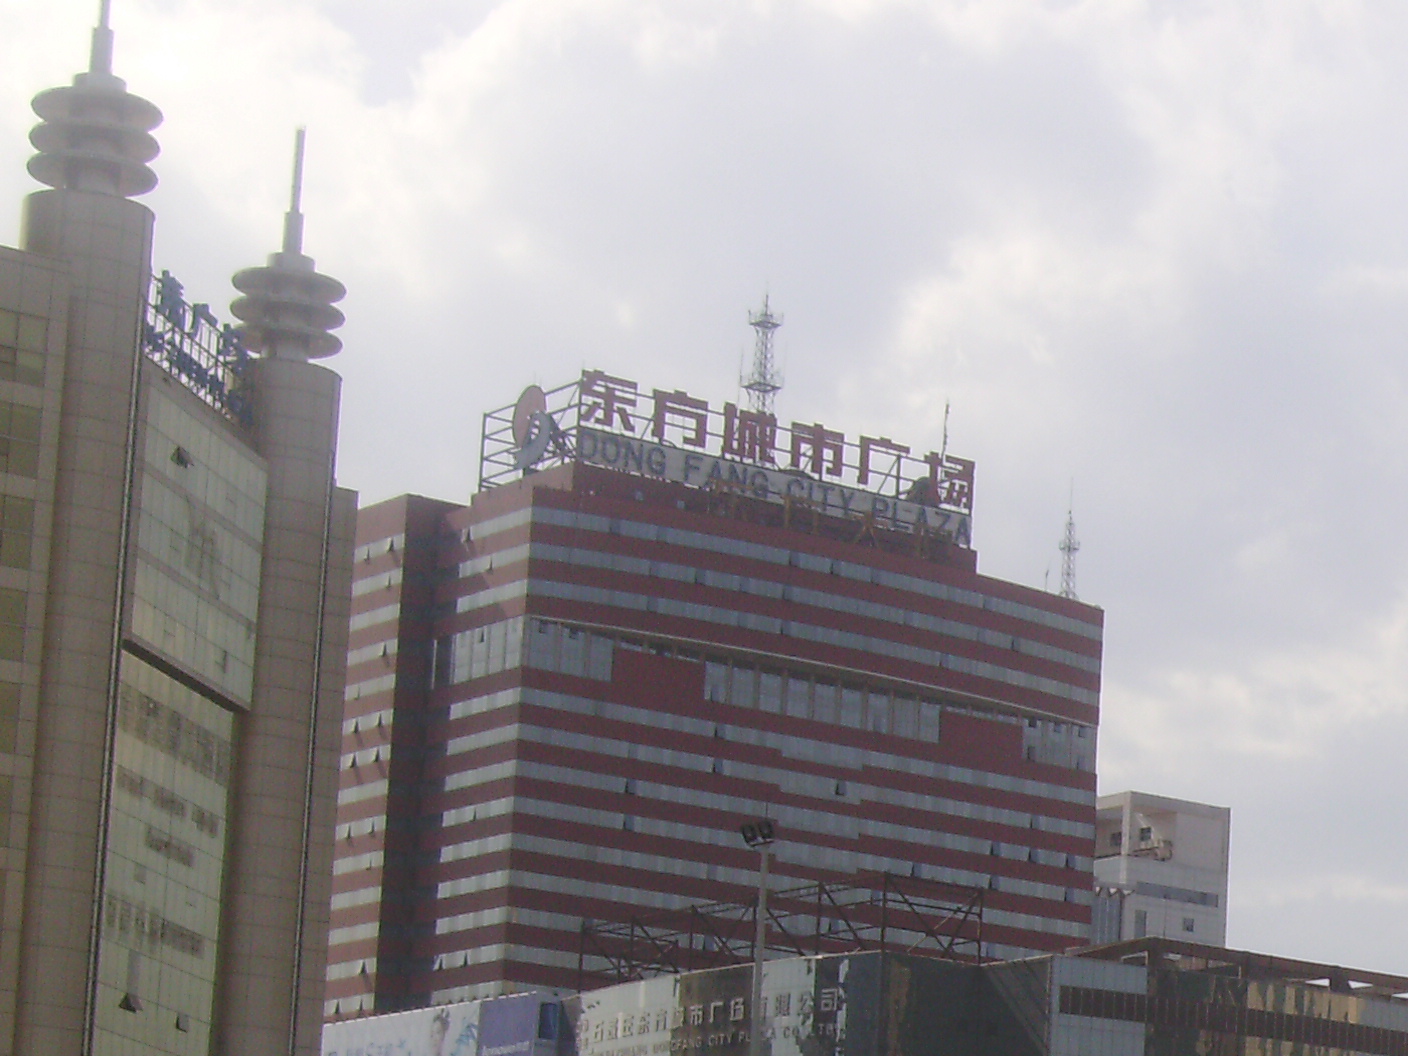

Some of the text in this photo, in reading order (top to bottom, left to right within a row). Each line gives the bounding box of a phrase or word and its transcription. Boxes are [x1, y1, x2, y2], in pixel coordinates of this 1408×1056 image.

[580, 369, 976, 510] 东方城市广场
[580, 430, 667, 476] DONG
[684, 454, 769, 499] FANG
[787, 477, 855, 517] CITY
[872, 497, 972, 549] PLAZA
